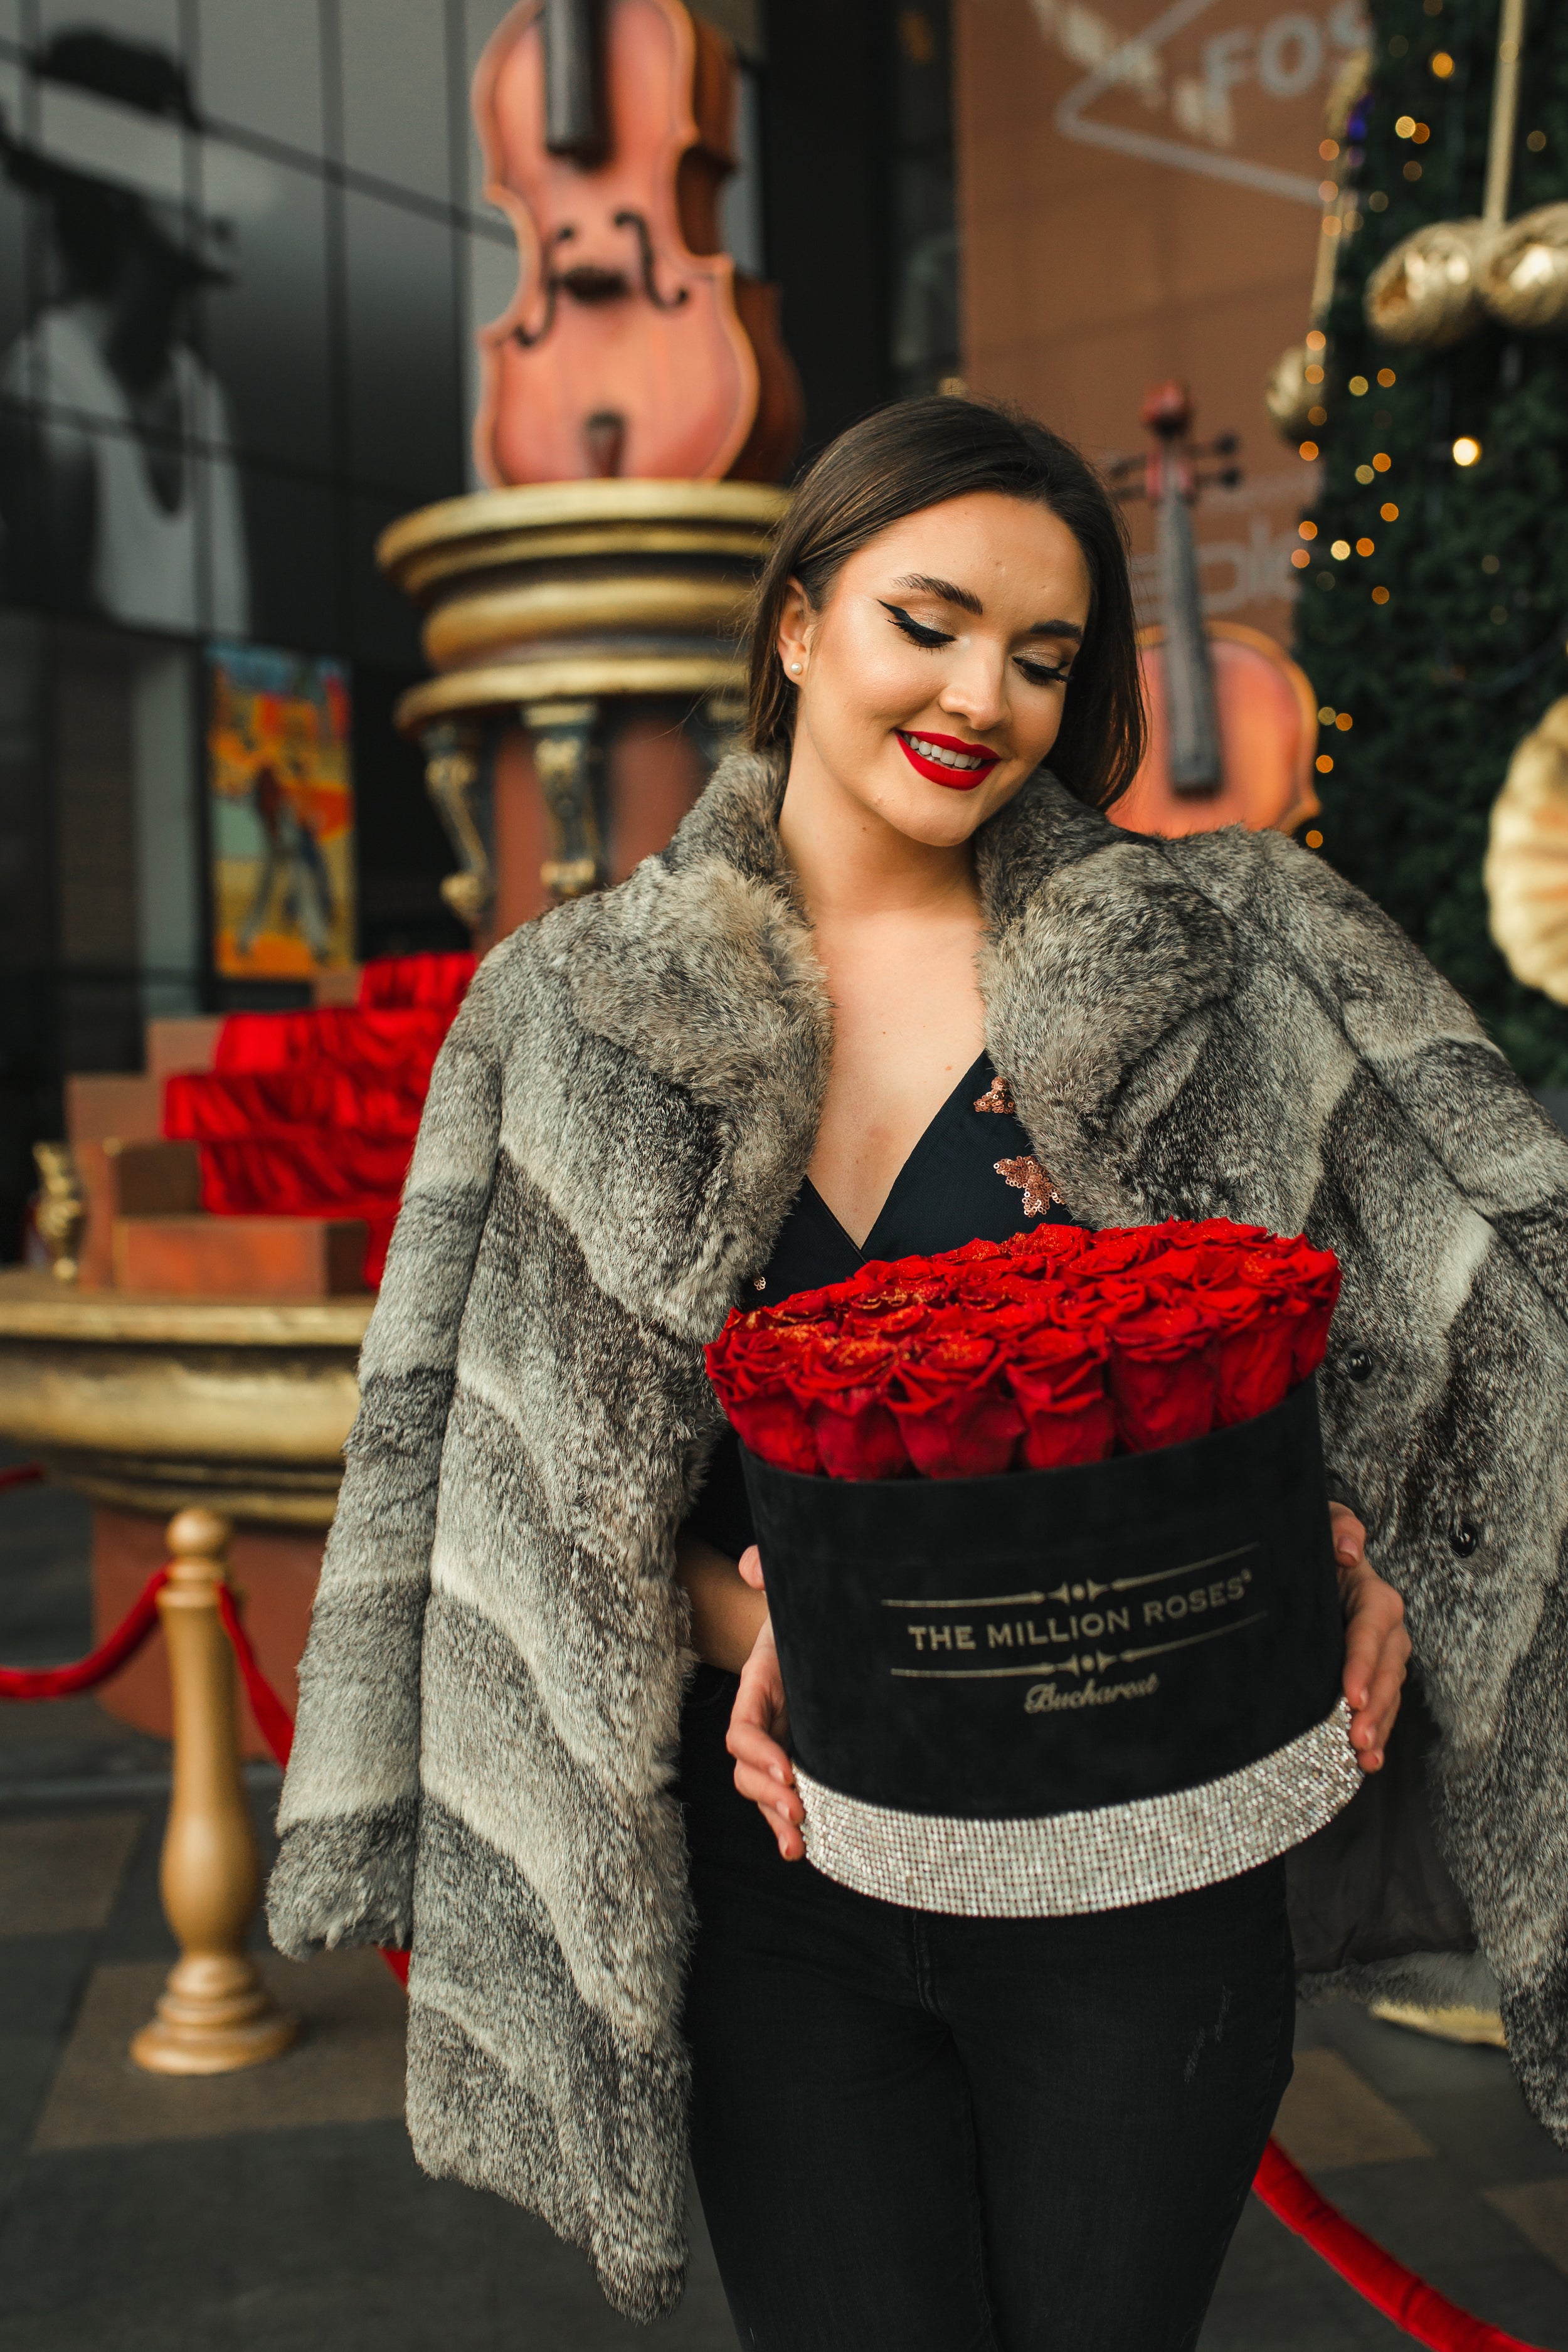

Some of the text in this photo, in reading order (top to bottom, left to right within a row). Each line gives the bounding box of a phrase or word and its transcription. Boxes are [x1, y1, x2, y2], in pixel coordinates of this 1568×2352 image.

[907, 1624, 977, 1651] THE
[987, 1607, 1130, 1648] MILLION
[1024, 1672, 1160, 1714] Bucharest
